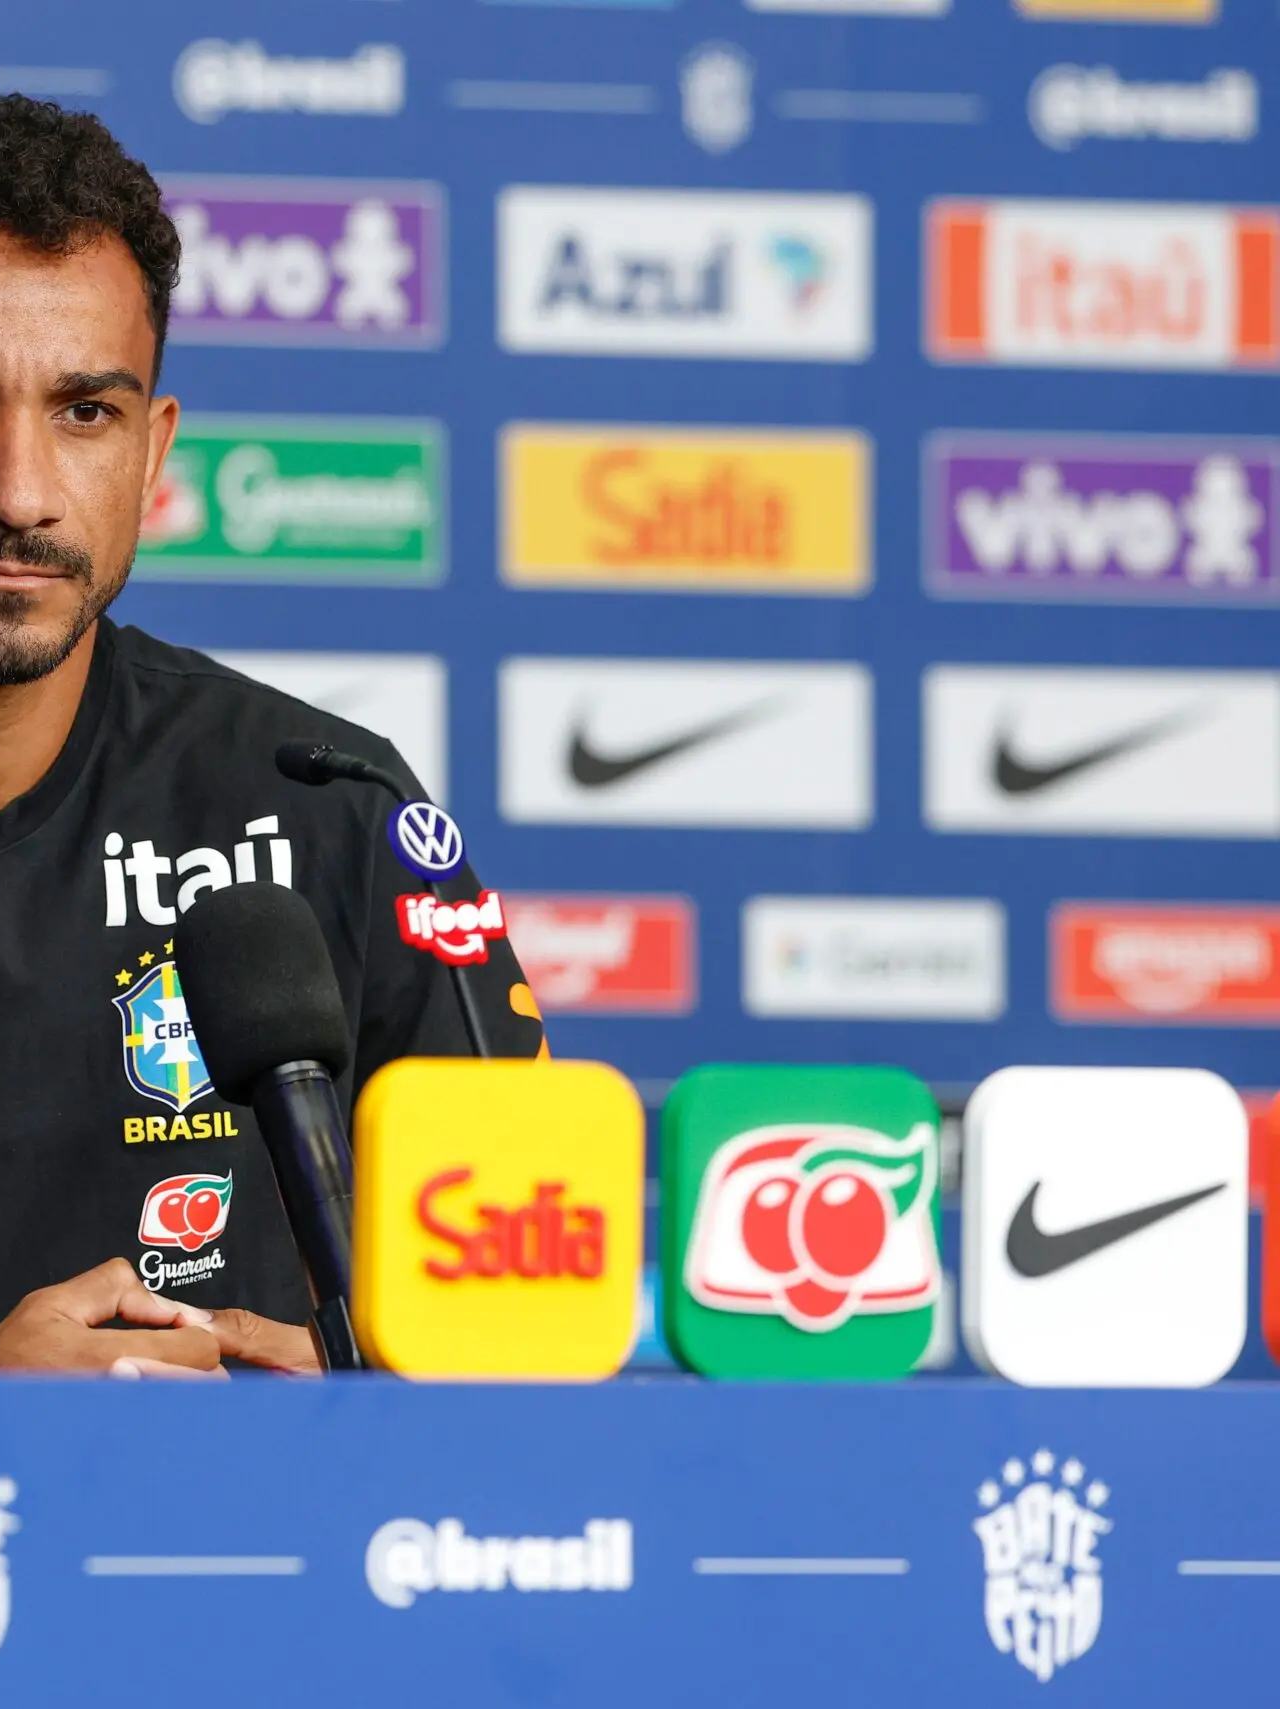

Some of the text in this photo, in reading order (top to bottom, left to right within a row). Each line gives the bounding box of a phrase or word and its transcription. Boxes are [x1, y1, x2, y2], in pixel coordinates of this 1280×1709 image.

[168, 203, 330, 318] ivo
[540, 233, 734, 320] Azul
[1015, 233, 1206, 338] itaú
[956, 459, 1177, 573] vivo
[405, 892, 504, 940] ifood
[124, 1111, 238, 1144] BRASIL
[414, 1168, 605, 1280] Sadia
[139, 1248, 226, 1291] Guaraná
[171, 1271, 213, 1287] ANTARCTICA
[365, 1516, 633, 1609] @brasil
